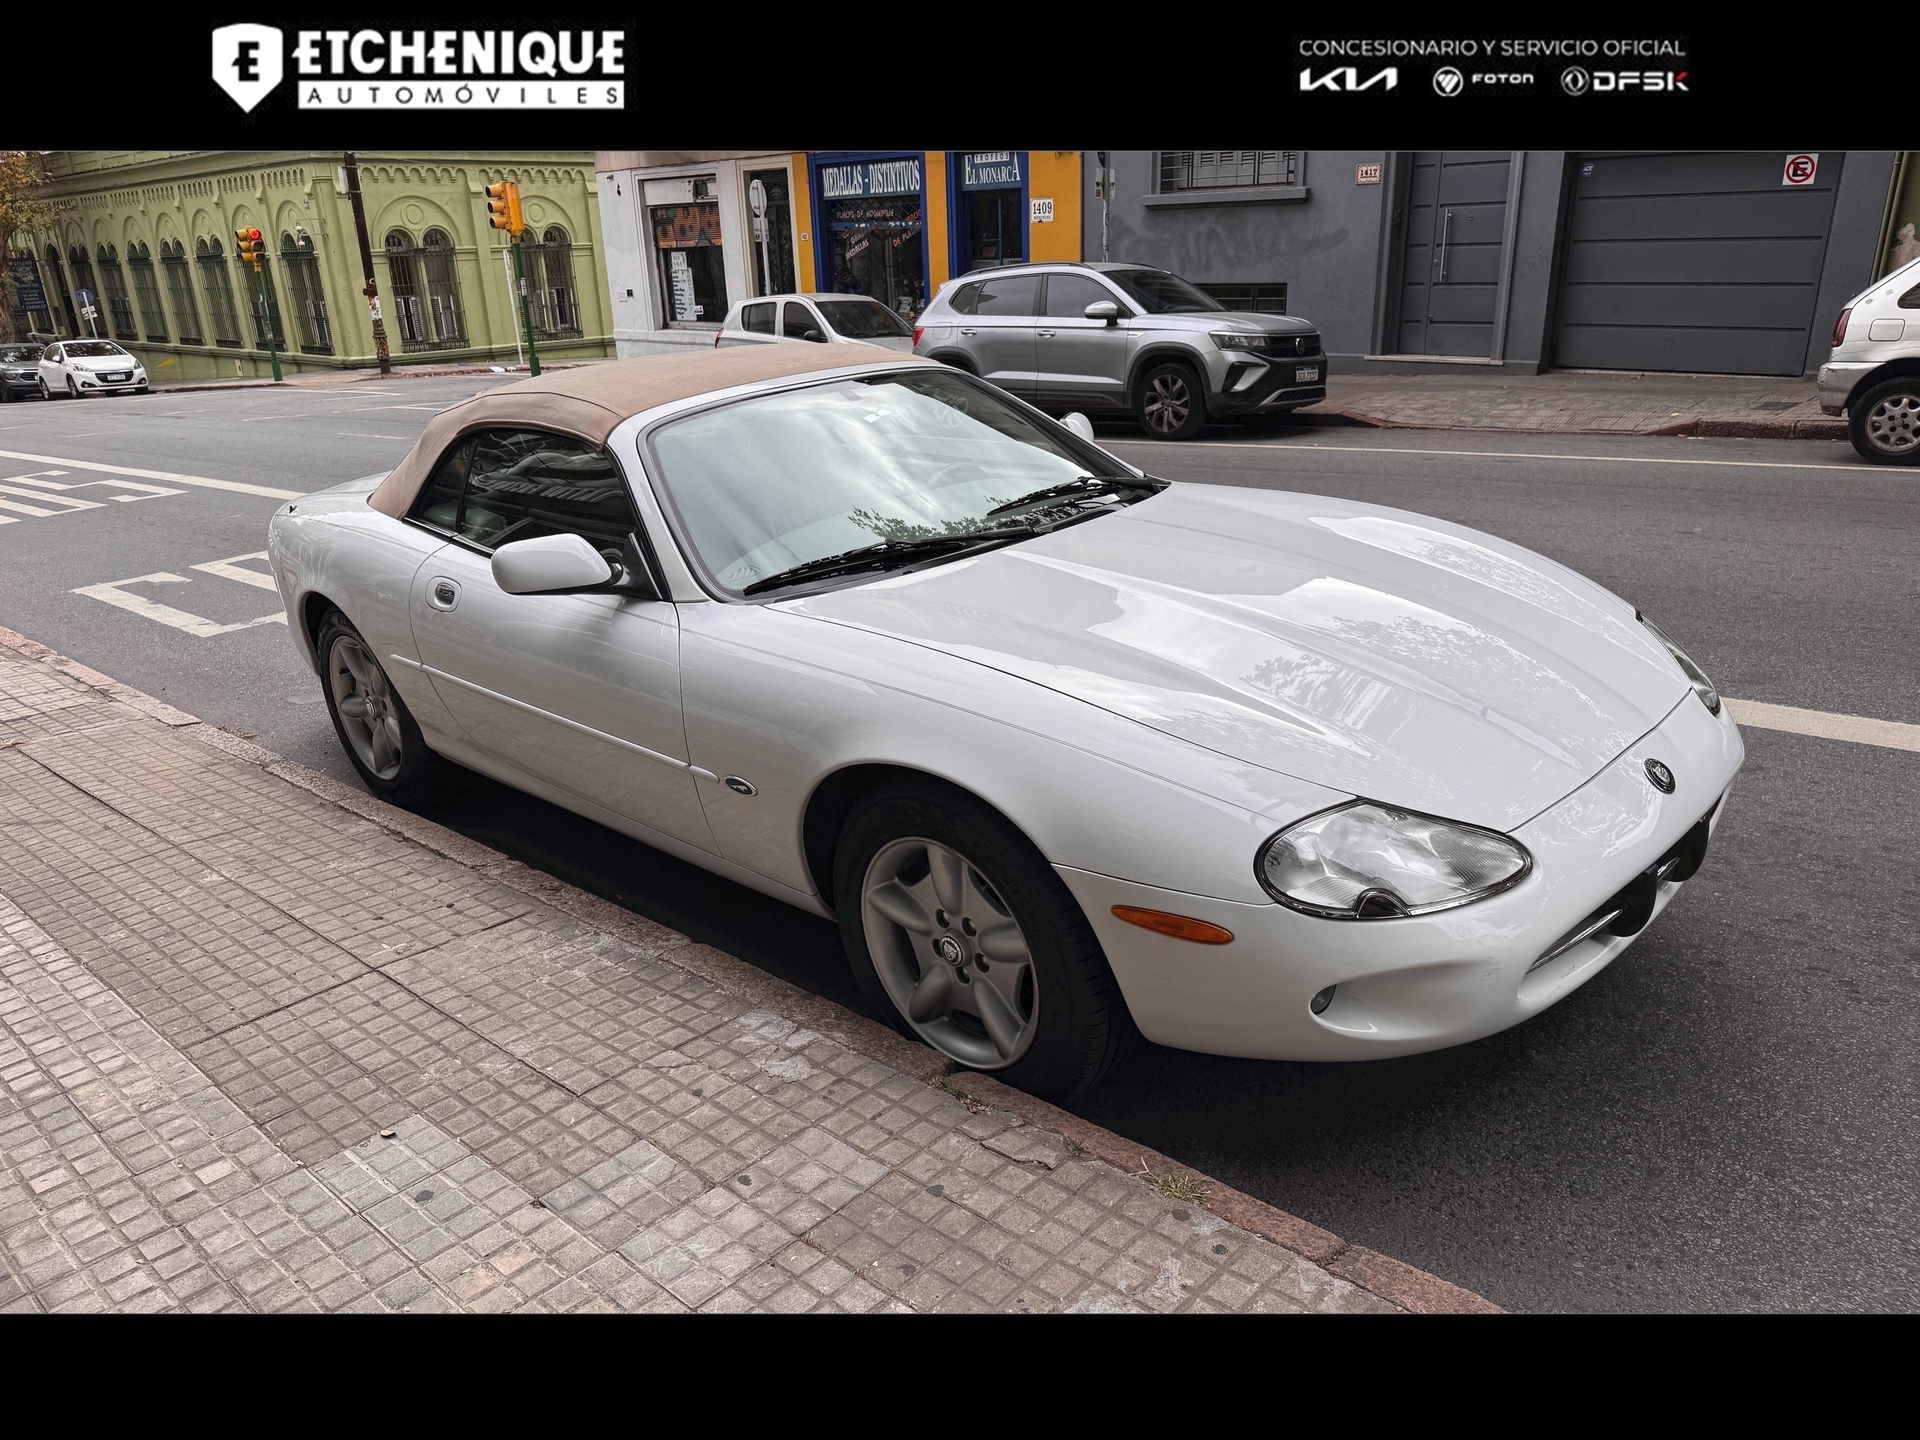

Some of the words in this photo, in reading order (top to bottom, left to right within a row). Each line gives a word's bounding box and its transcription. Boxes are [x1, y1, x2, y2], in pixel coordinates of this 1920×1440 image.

[975, 152, 1009, 162] TROFEOS
[822, 164, 864, 197] MEDALLAS
[868, 159, 921, 194] DISTINTIVOS
[1360, 168, 1378, 176] 1417
[1033, 201, 1052, 215] 1409
[892, 236, 901, 247] DE
[845, 238, 869, 261] MEDALLAS
